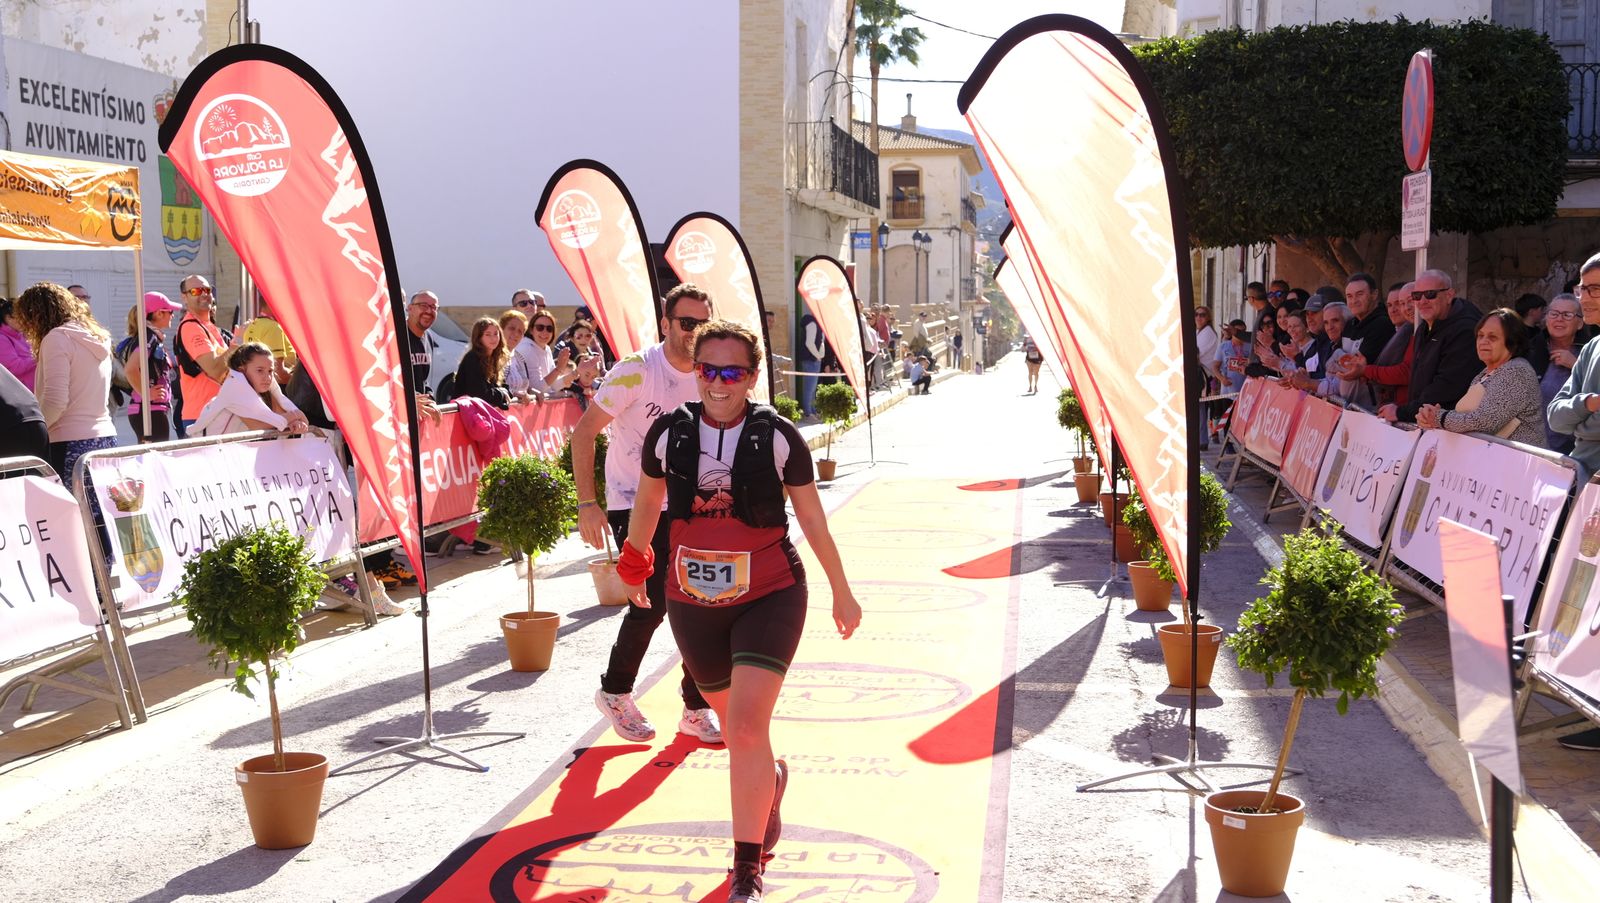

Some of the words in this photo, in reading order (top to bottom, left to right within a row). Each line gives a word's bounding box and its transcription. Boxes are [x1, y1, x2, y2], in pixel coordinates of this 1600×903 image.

[19, 77, 145, 125] EXCELENTÍSIMO
[26, 121, 147, 163] AYUNTAMIENTO
[419, 444, 483, 493] EOLIA
[162, 471, 303, 509] AYUNTAMIENTO
[309, 466, 332, 485] DE
[18, 519, 51, 546] DE
[170, 491, 343, 557] CANTORIA
[1529, 503, 1549, 531] DE
[688, 561, 732, 584] 251
[577, 840, 808, 864] PLVORA
[826, 849, 888, 866] LA
